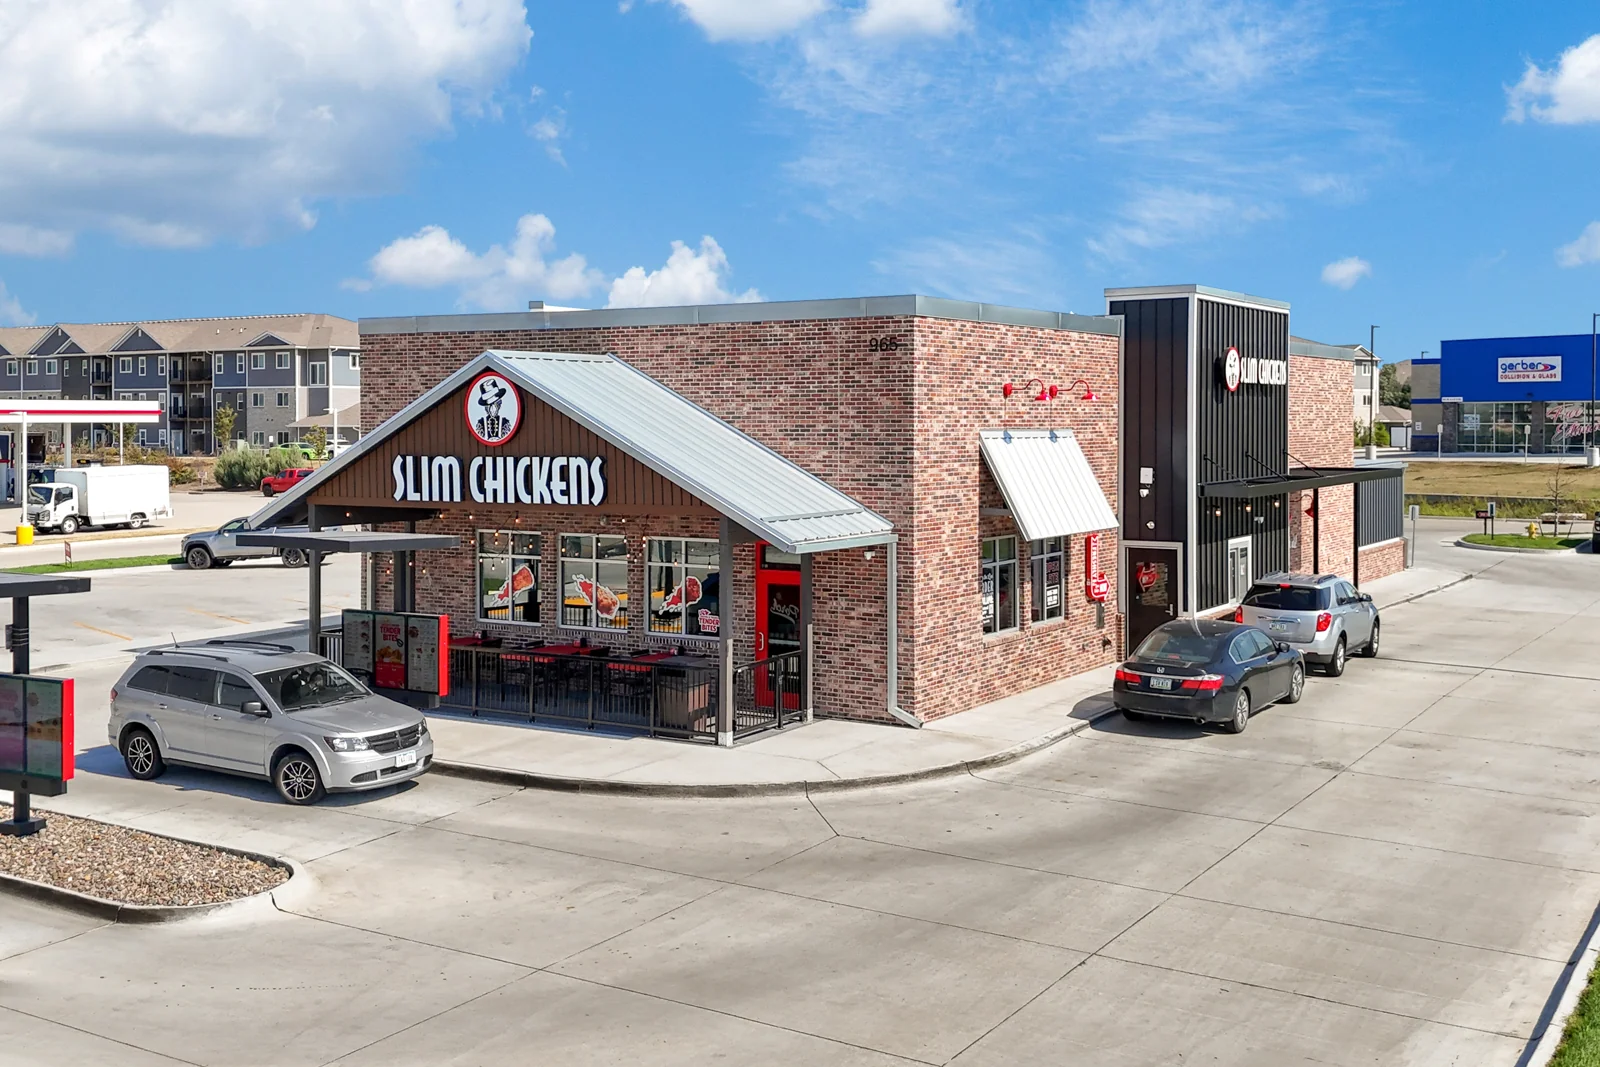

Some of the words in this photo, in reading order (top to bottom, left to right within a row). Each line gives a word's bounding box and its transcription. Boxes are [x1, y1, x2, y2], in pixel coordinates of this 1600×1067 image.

[869, 337, 898, 351] 965
[1240, 356, 1258, 384] SLIM
[1258, 358, 1287, 386] CHICKENS
[1500, 359, 1542, 373] gerber
[392, 454, 463, 503] SLIM
[469, 455, 605, 507] CHICKENS
[699, 617, 720, 625] TENDER
[702, 624, 717, 632] BITES
[380, 626, 401, 635] TENDER
